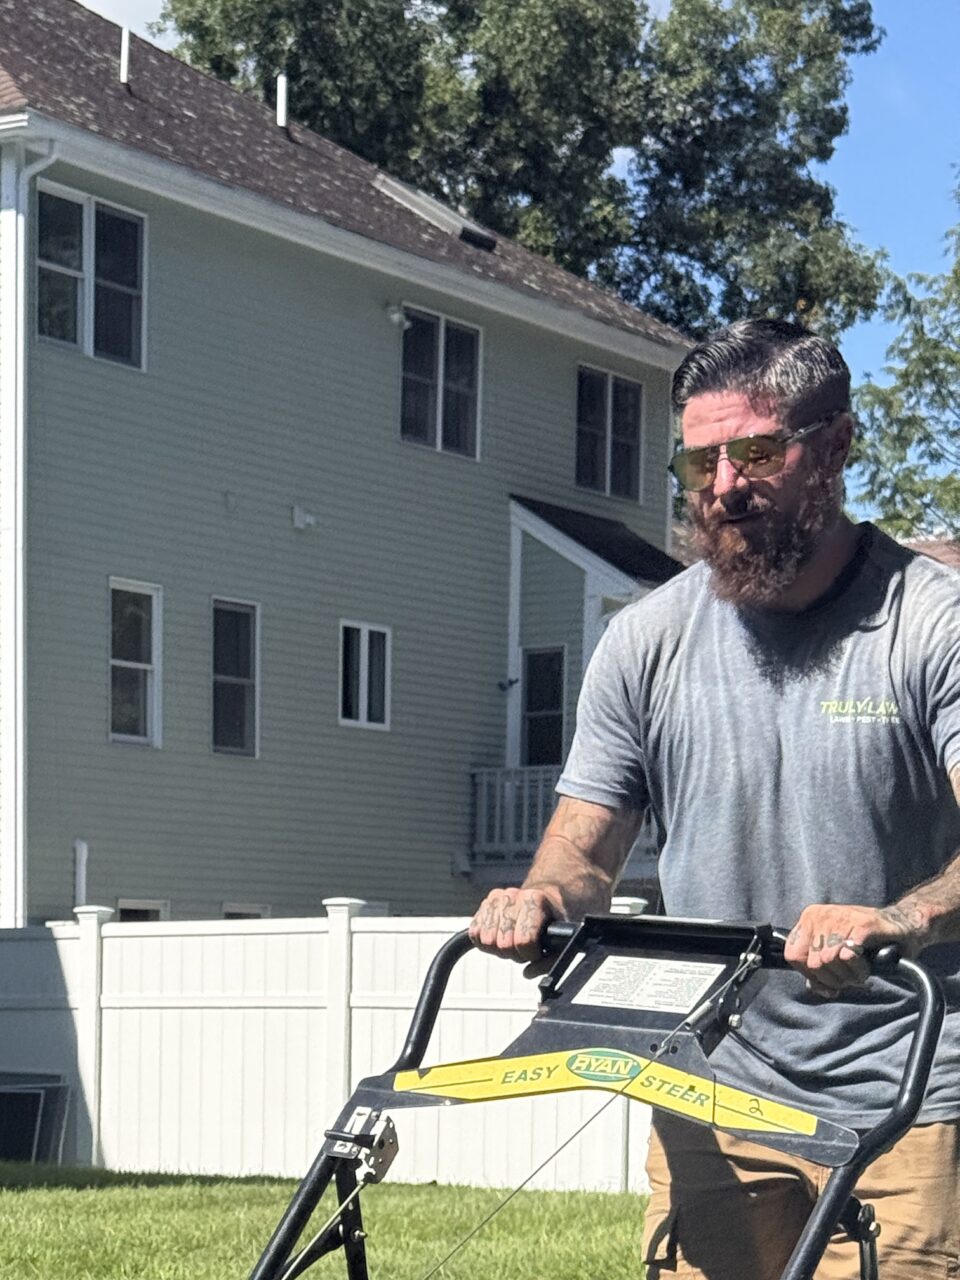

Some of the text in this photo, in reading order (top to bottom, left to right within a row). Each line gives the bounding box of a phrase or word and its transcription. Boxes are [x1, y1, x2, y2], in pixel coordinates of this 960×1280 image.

[820, 697, 871, 714] TRULY
[570, 1055, 633, 1075] RYAN
[500, 1065, 711, 1107] EASY STEER
[748, 1098, 764, 1116] 2
